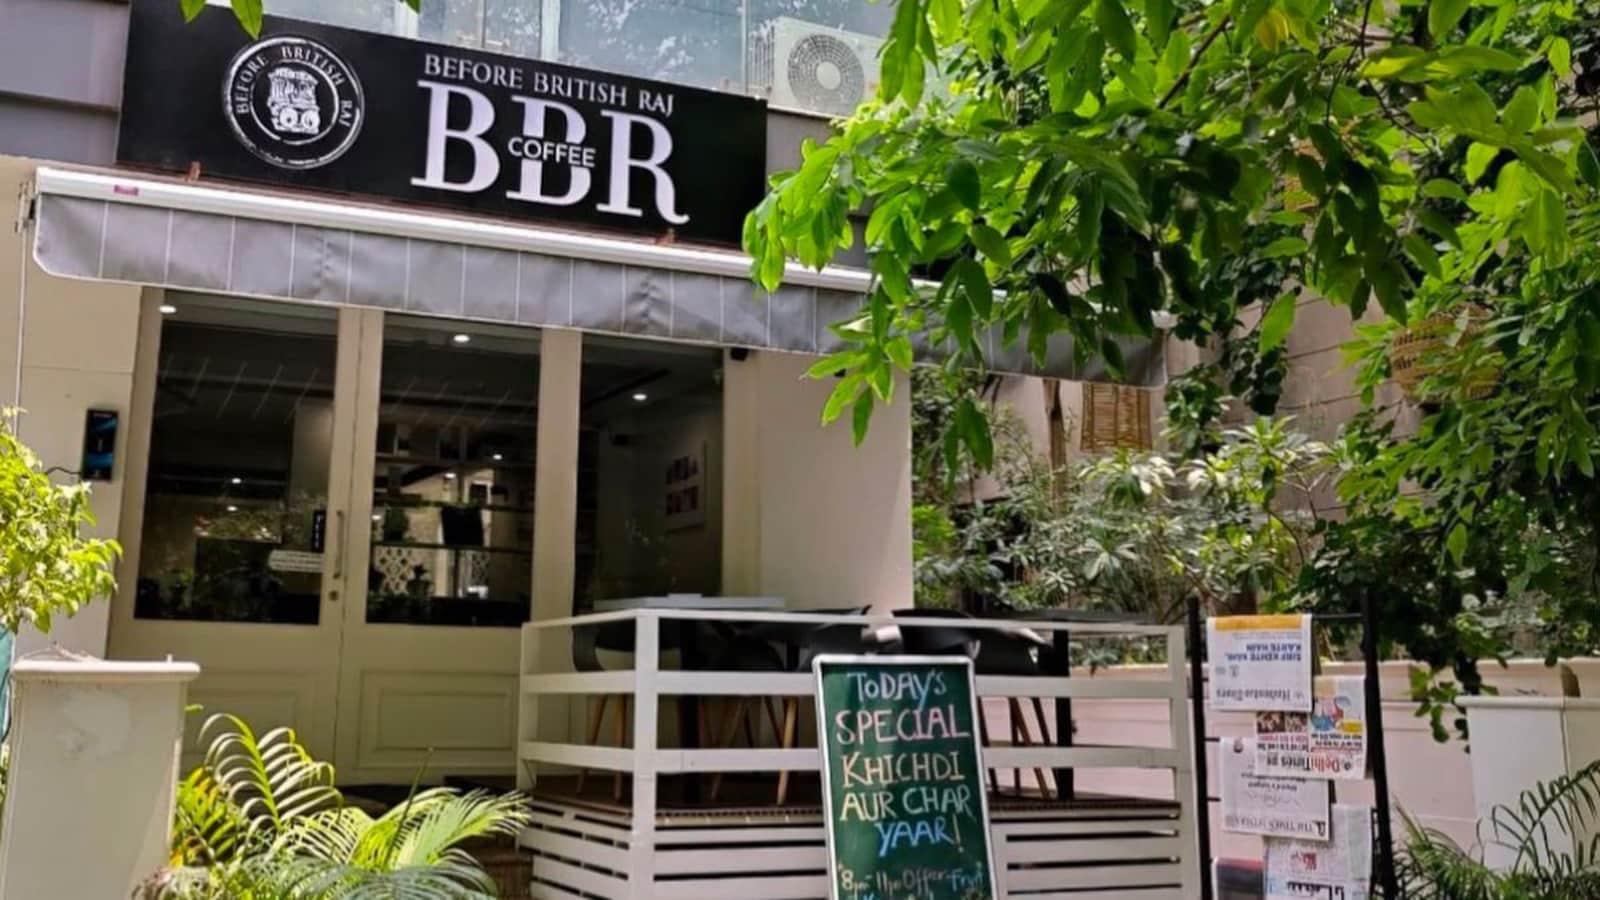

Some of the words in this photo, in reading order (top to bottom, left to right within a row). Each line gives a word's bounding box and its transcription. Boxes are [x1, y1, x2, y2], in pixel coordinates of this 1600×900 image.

[235, 54, 270, 115] BEFORE
[280, 46, 346, 86] BRITISH
[338, 99, 354, 128] RAJ
[424, 53, 524, 90] BEFORE
[533, 71, 628, 107] BRITISH
[638, 89, 675, 117] RAJ
[410, 79, 691, 225] BBR
[507, 136, 597, 168] COFFEE
[835, 704, 971, 746] SPECIAL
[840, 751, 966, 788] KHICHDI
[839, 791, 898, 822] AUR
[902, 784, 977, 822] CHAR
[874, 812, 965, 858] YAAR!
